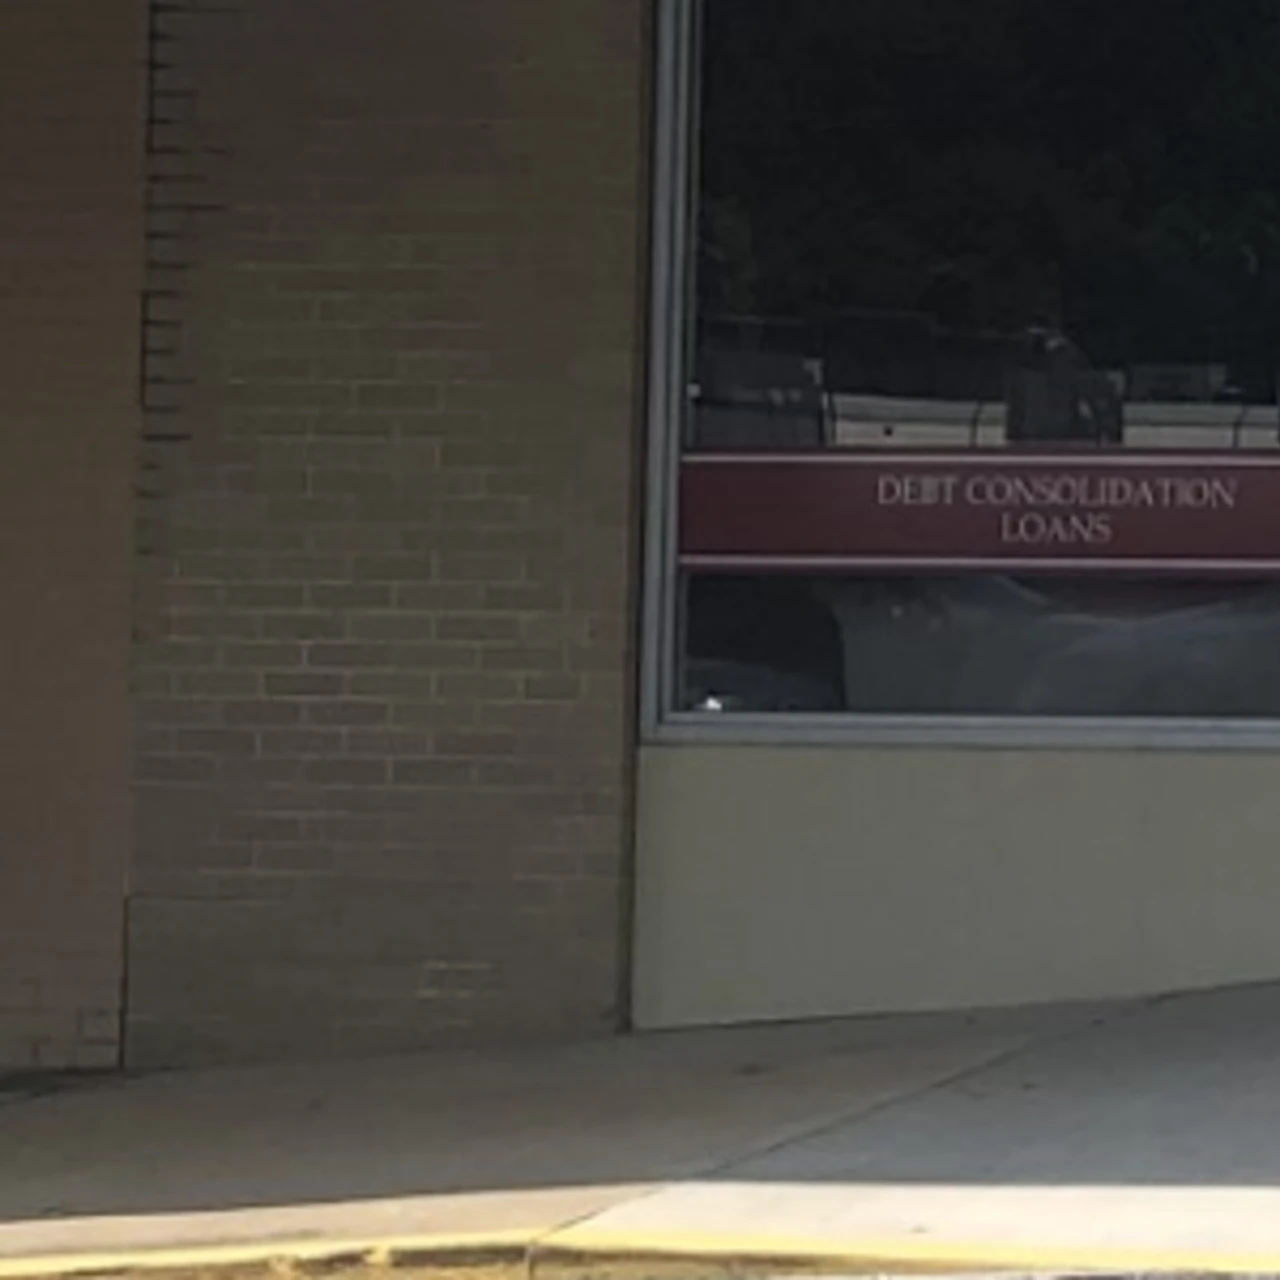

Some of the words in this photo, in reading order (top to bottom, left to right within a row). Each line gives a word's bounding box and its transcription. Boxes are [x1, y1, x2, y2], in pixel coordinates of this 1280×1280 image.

[877, 475, 956, 505] DEBT
[964, 475, 1237, 508] CONSOLIDATION
[1000, 511, 1112, 543] LOANS
